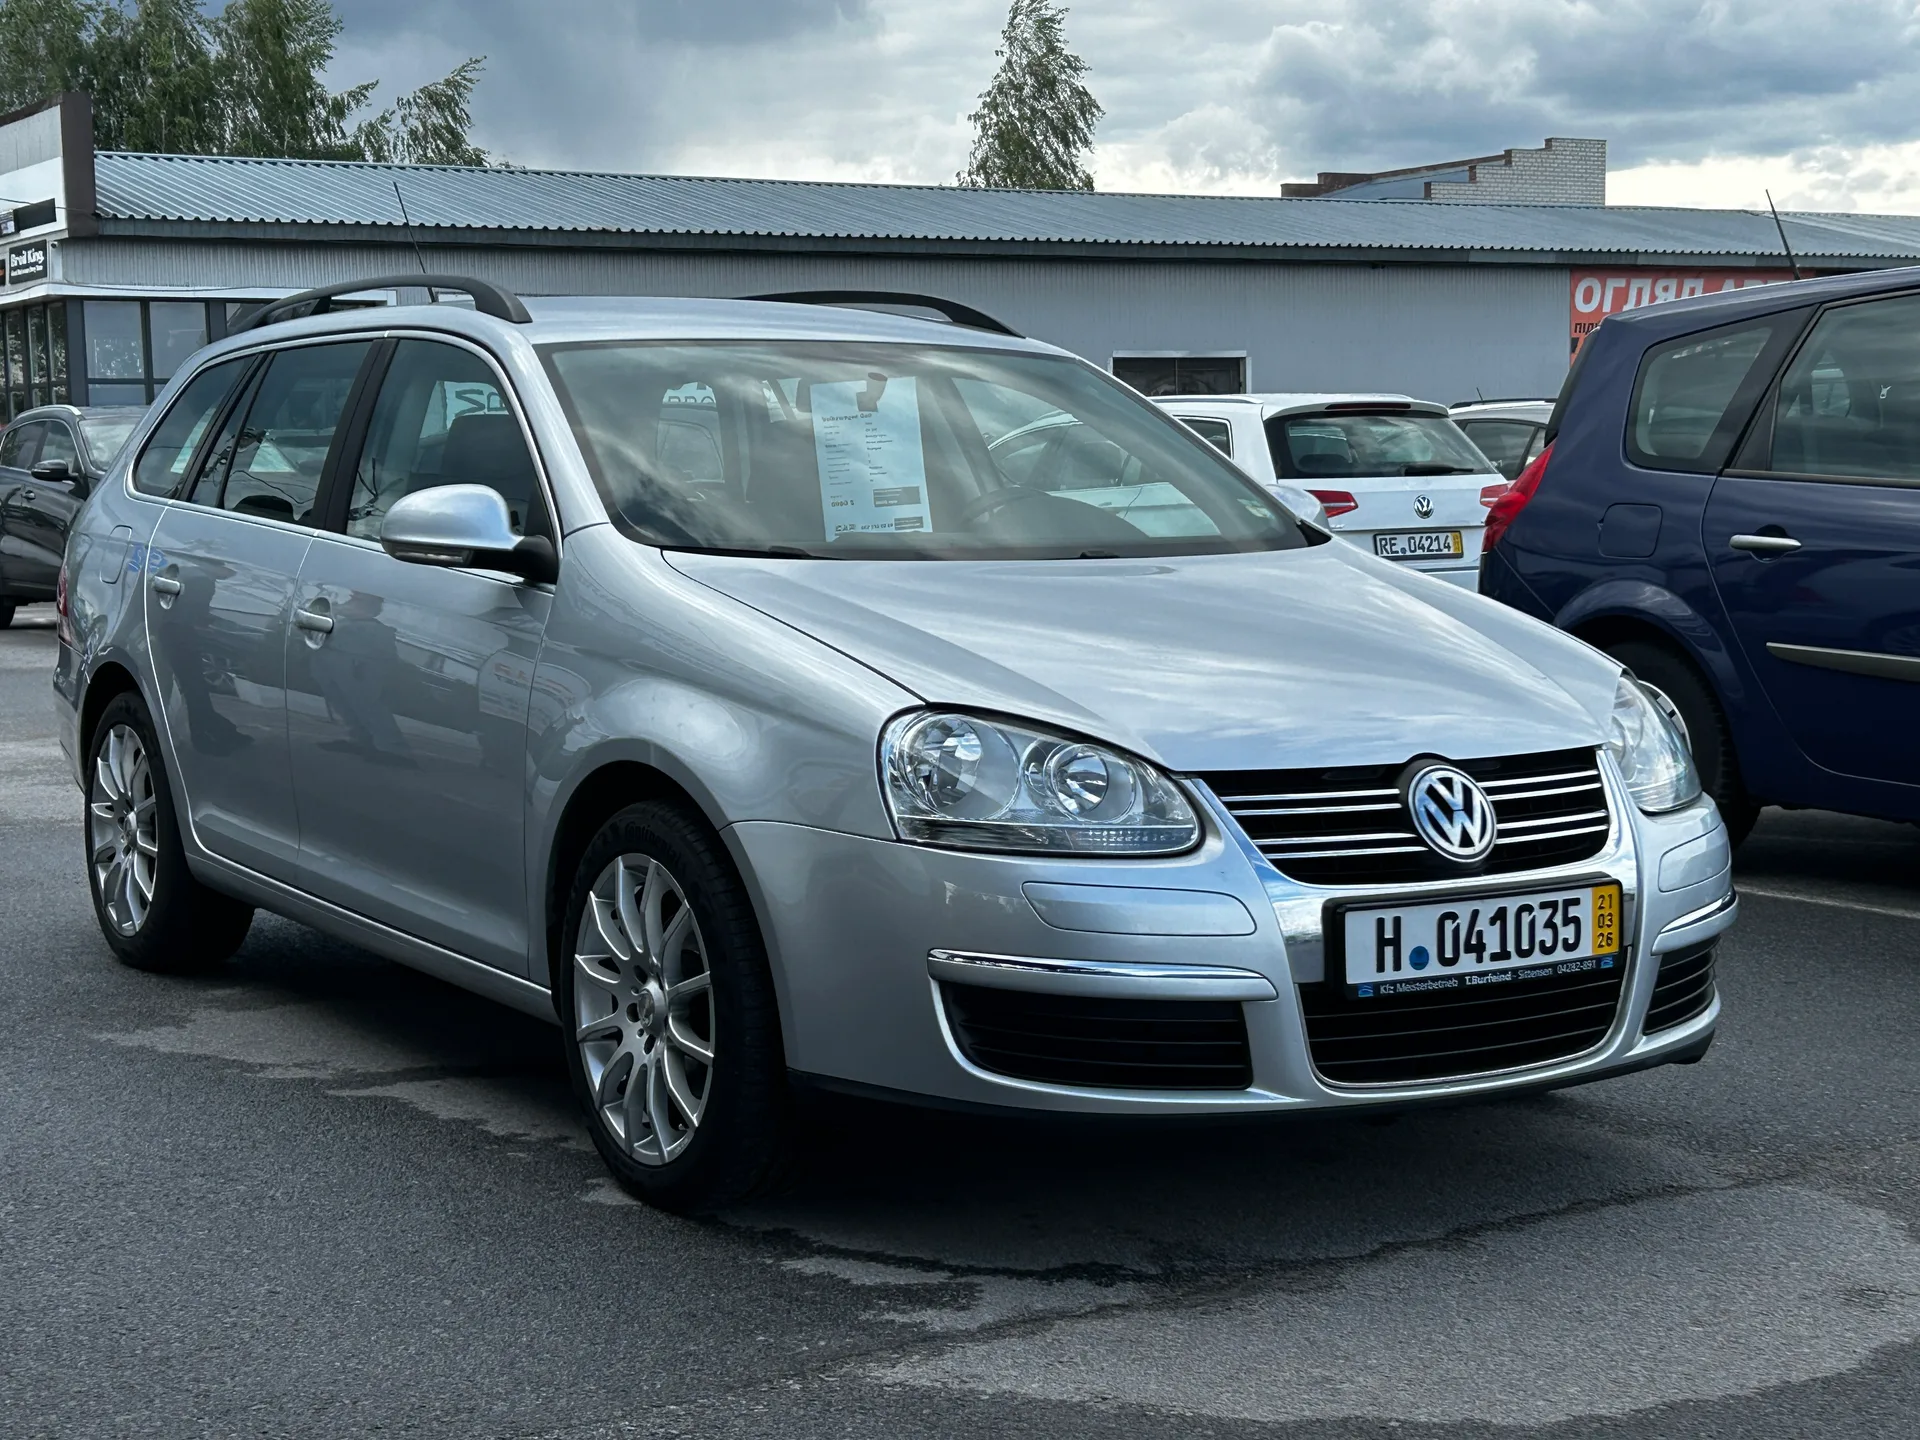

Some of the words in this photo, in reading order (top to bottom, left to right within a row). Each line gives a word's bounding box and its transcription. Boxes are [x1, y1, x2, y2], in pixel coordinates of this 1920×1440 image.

[27, 248, 44, 264] King
[1379, 536, 1397, 555] RE
[1407, 534, 1452, 553] 04214
[1597, 893, 1614, 910] 21
[1597, 912, 1614, 929] 03
[1375, 915, 1402, 973] H
[1437, 896, 1582, 968] 041035
[1597, 931, 1614, 949] 26
